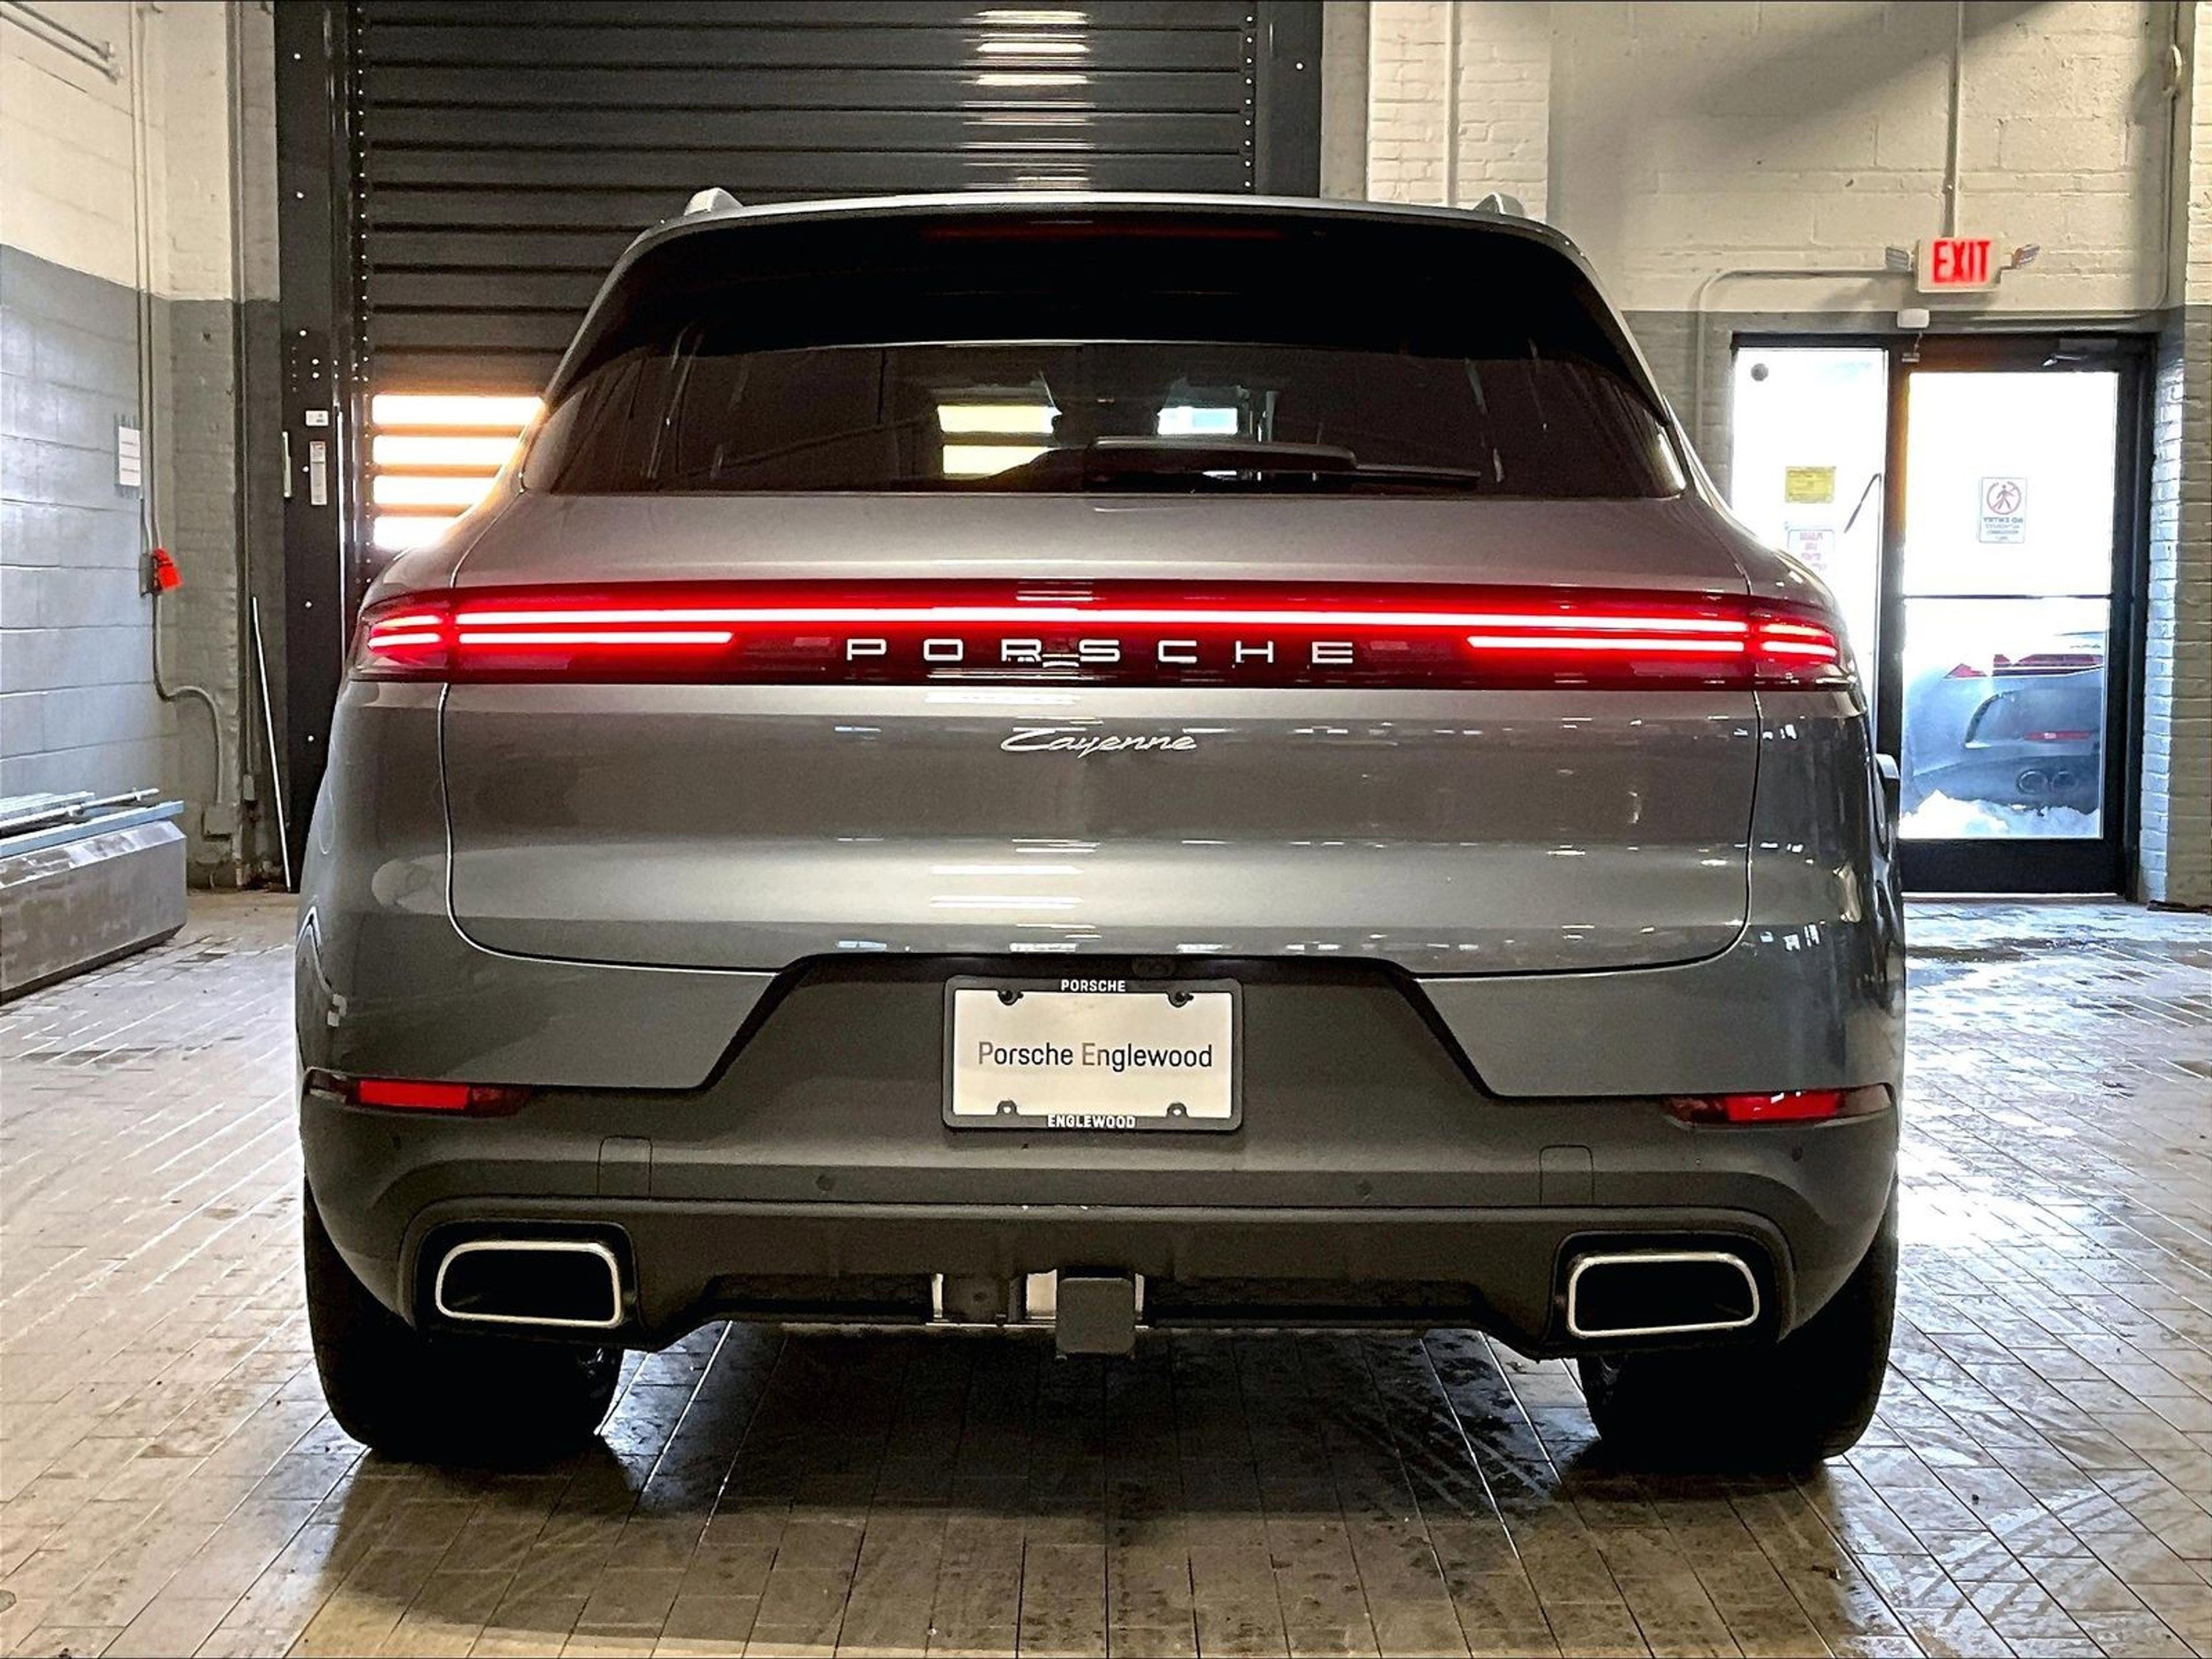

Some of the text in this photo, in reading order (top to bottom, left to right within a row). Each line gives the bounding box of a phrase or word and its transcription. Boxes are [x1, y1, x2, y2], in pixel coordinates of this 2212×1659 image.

[1934, 241, 1990, 283] EXIT
[846, 638, 1353, 664] PORSCHE
[1001, 728, 1197, 759] Cayenne
[1060, 980, 1126, 993] PORSCHE
[979, 1041, 1213, 1073] Porsche Englewood
[1047, 1114, 1137, 1129] ENGLEWOOD
